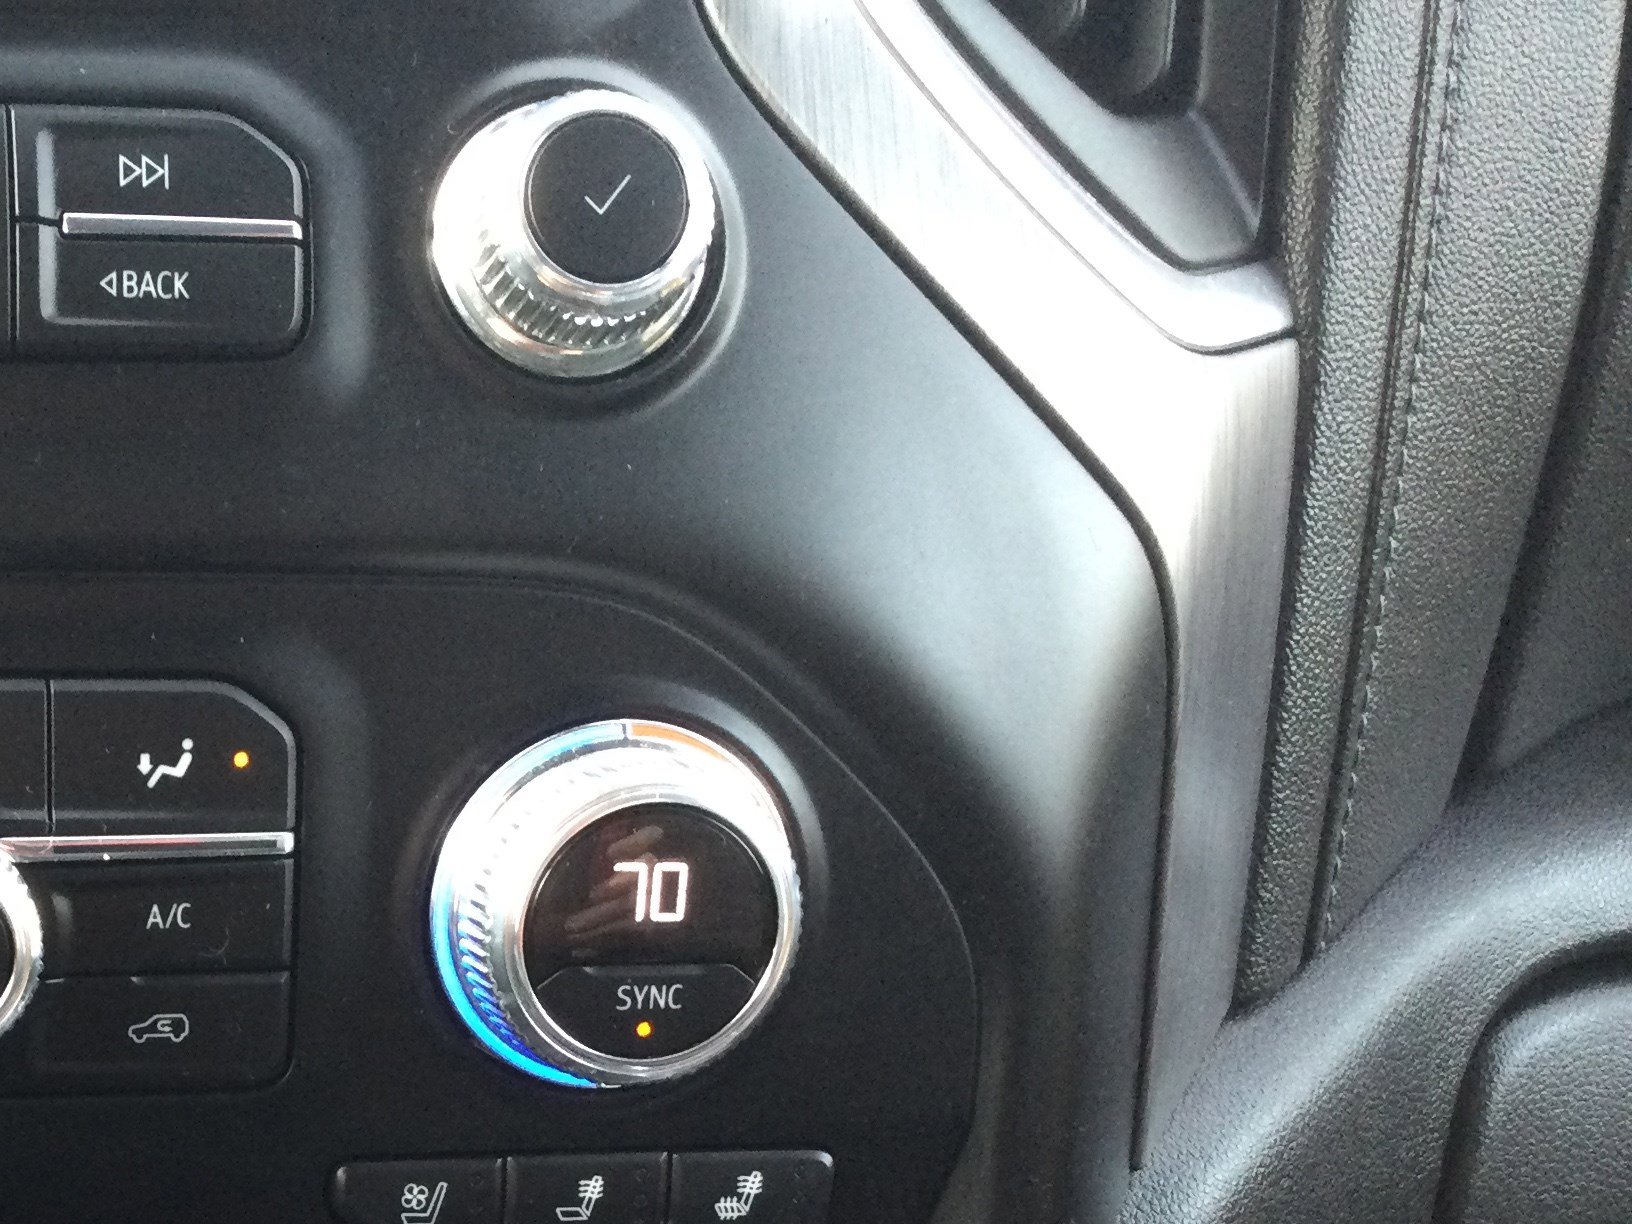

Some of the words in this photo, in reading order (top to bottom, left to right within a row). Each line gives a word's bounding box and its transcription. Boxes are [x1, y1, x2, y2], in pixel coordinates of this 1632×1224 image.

[122, 269, 190, 299] BACK
[613, 861, 689, 922] 70
[145, 902, 192, 930] A/C
[616, 983, 684, 1011] SYNC
